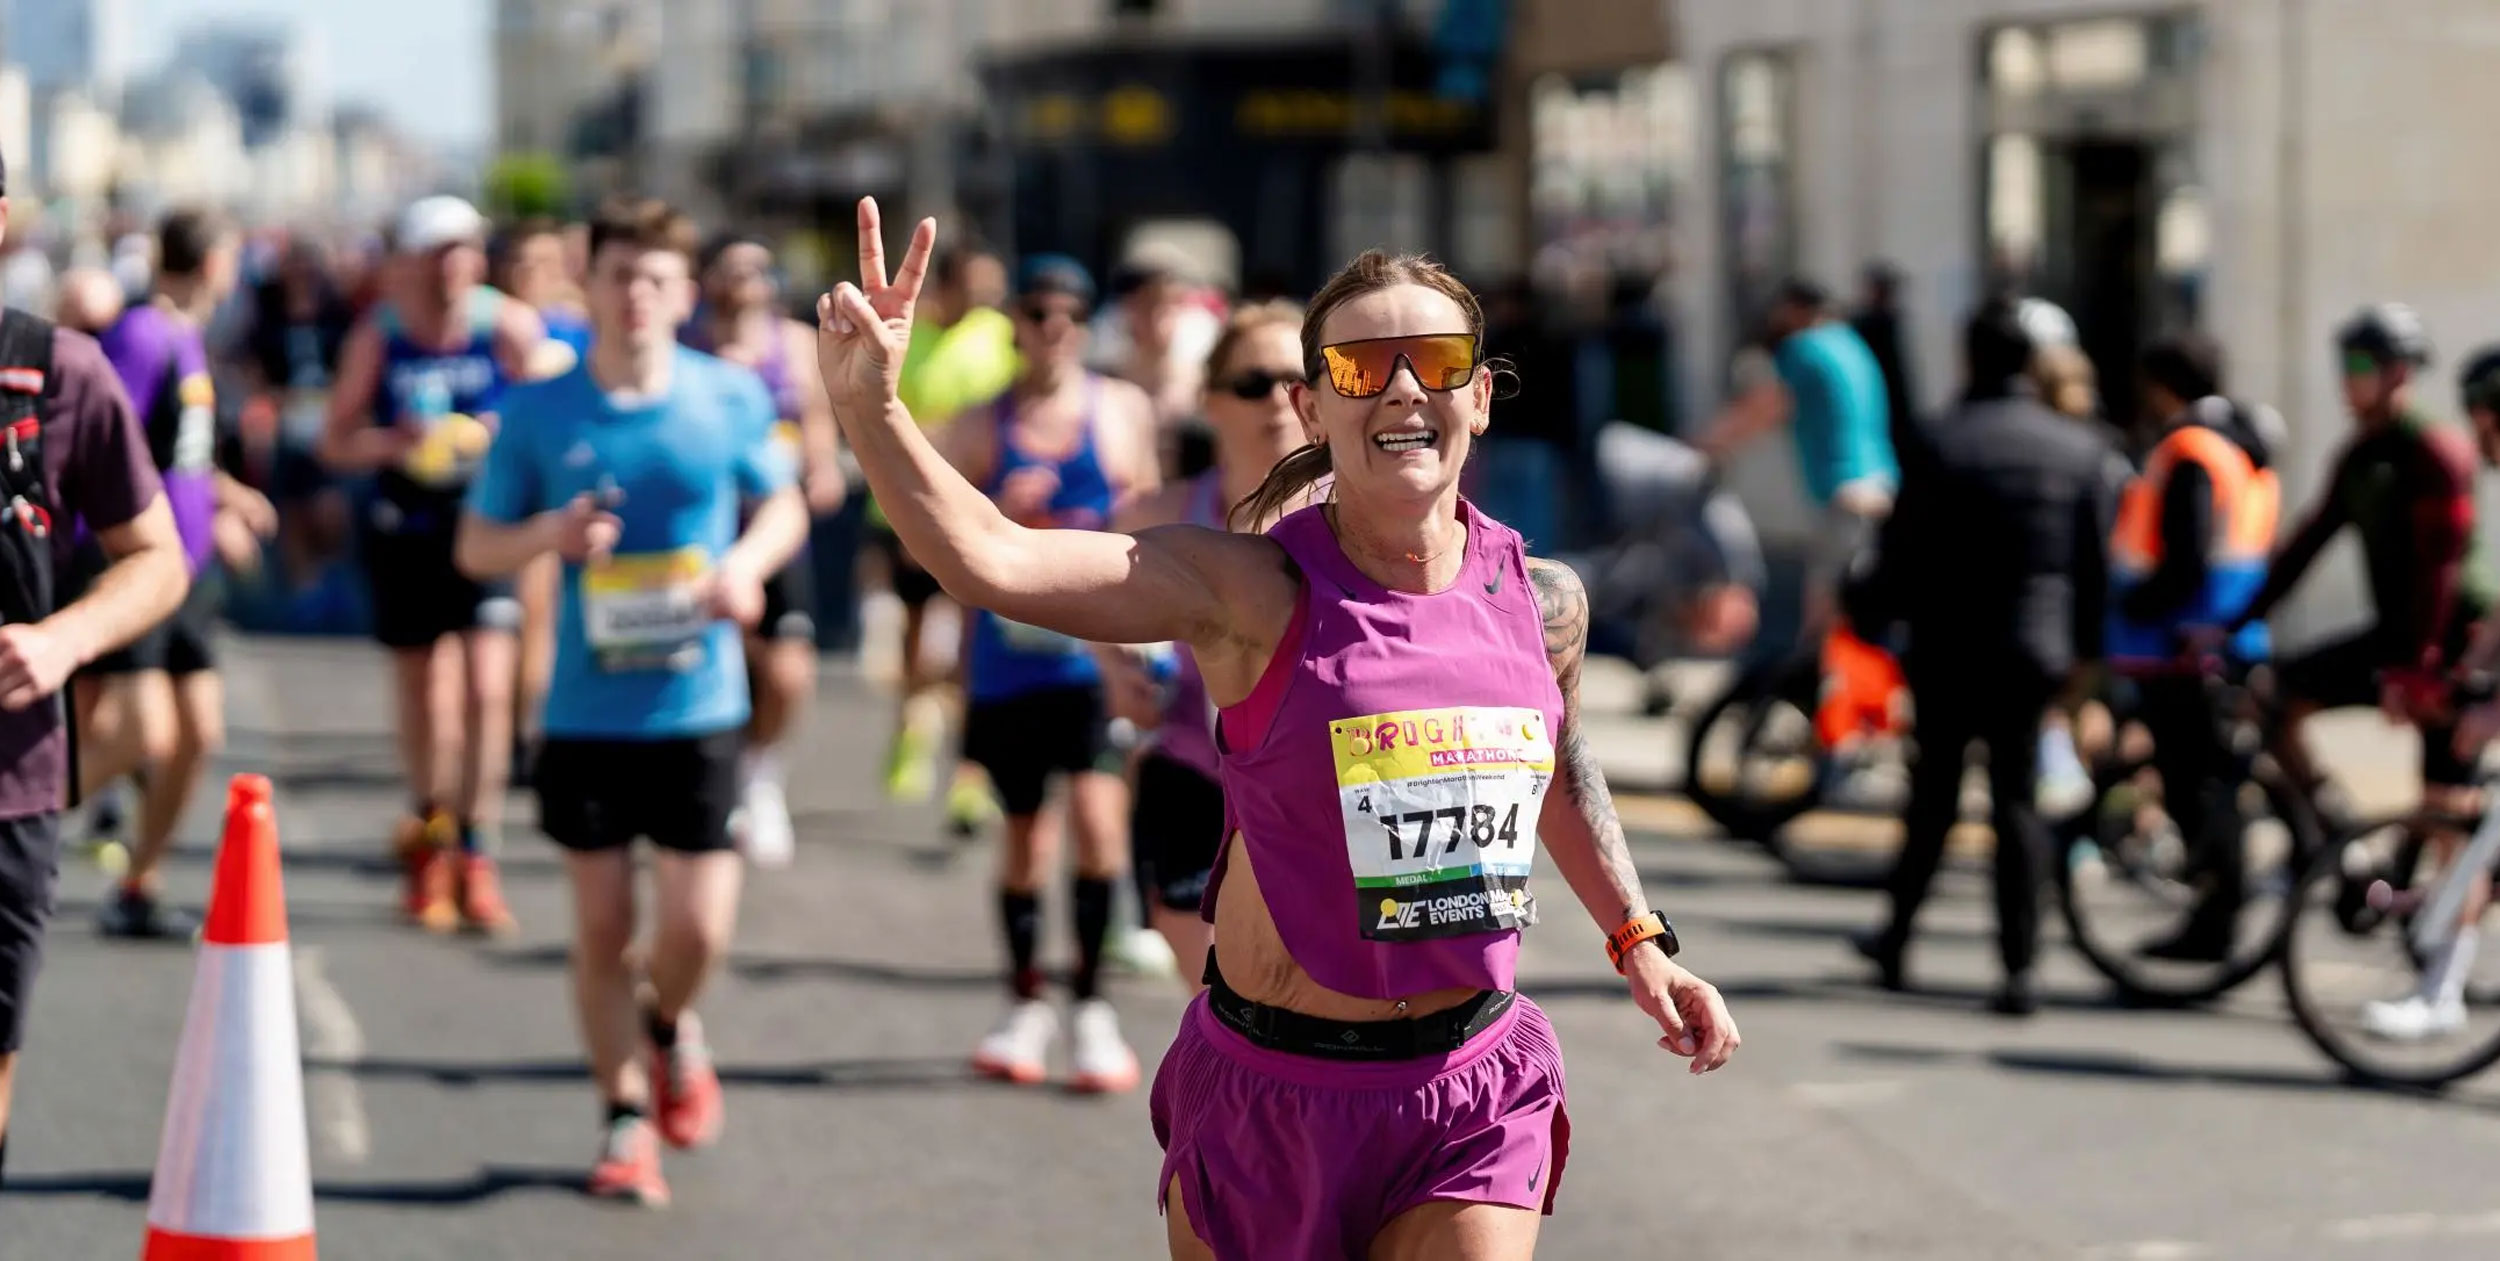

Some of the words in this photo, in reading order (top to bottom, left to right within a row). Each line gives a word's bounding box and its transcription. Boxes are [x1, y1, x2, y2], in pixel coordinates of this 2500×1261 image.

[1431, 749, 1517, 767] MARATHON
[1358, 795, 1373, 814] 4
[1379, 803, 1519, 861] 17784
[1396, 874, 1428, 887] MEDAL
[1428, 891, 1490, 911] LONDON
[1430, 905, 1486, 926] EVENTS
